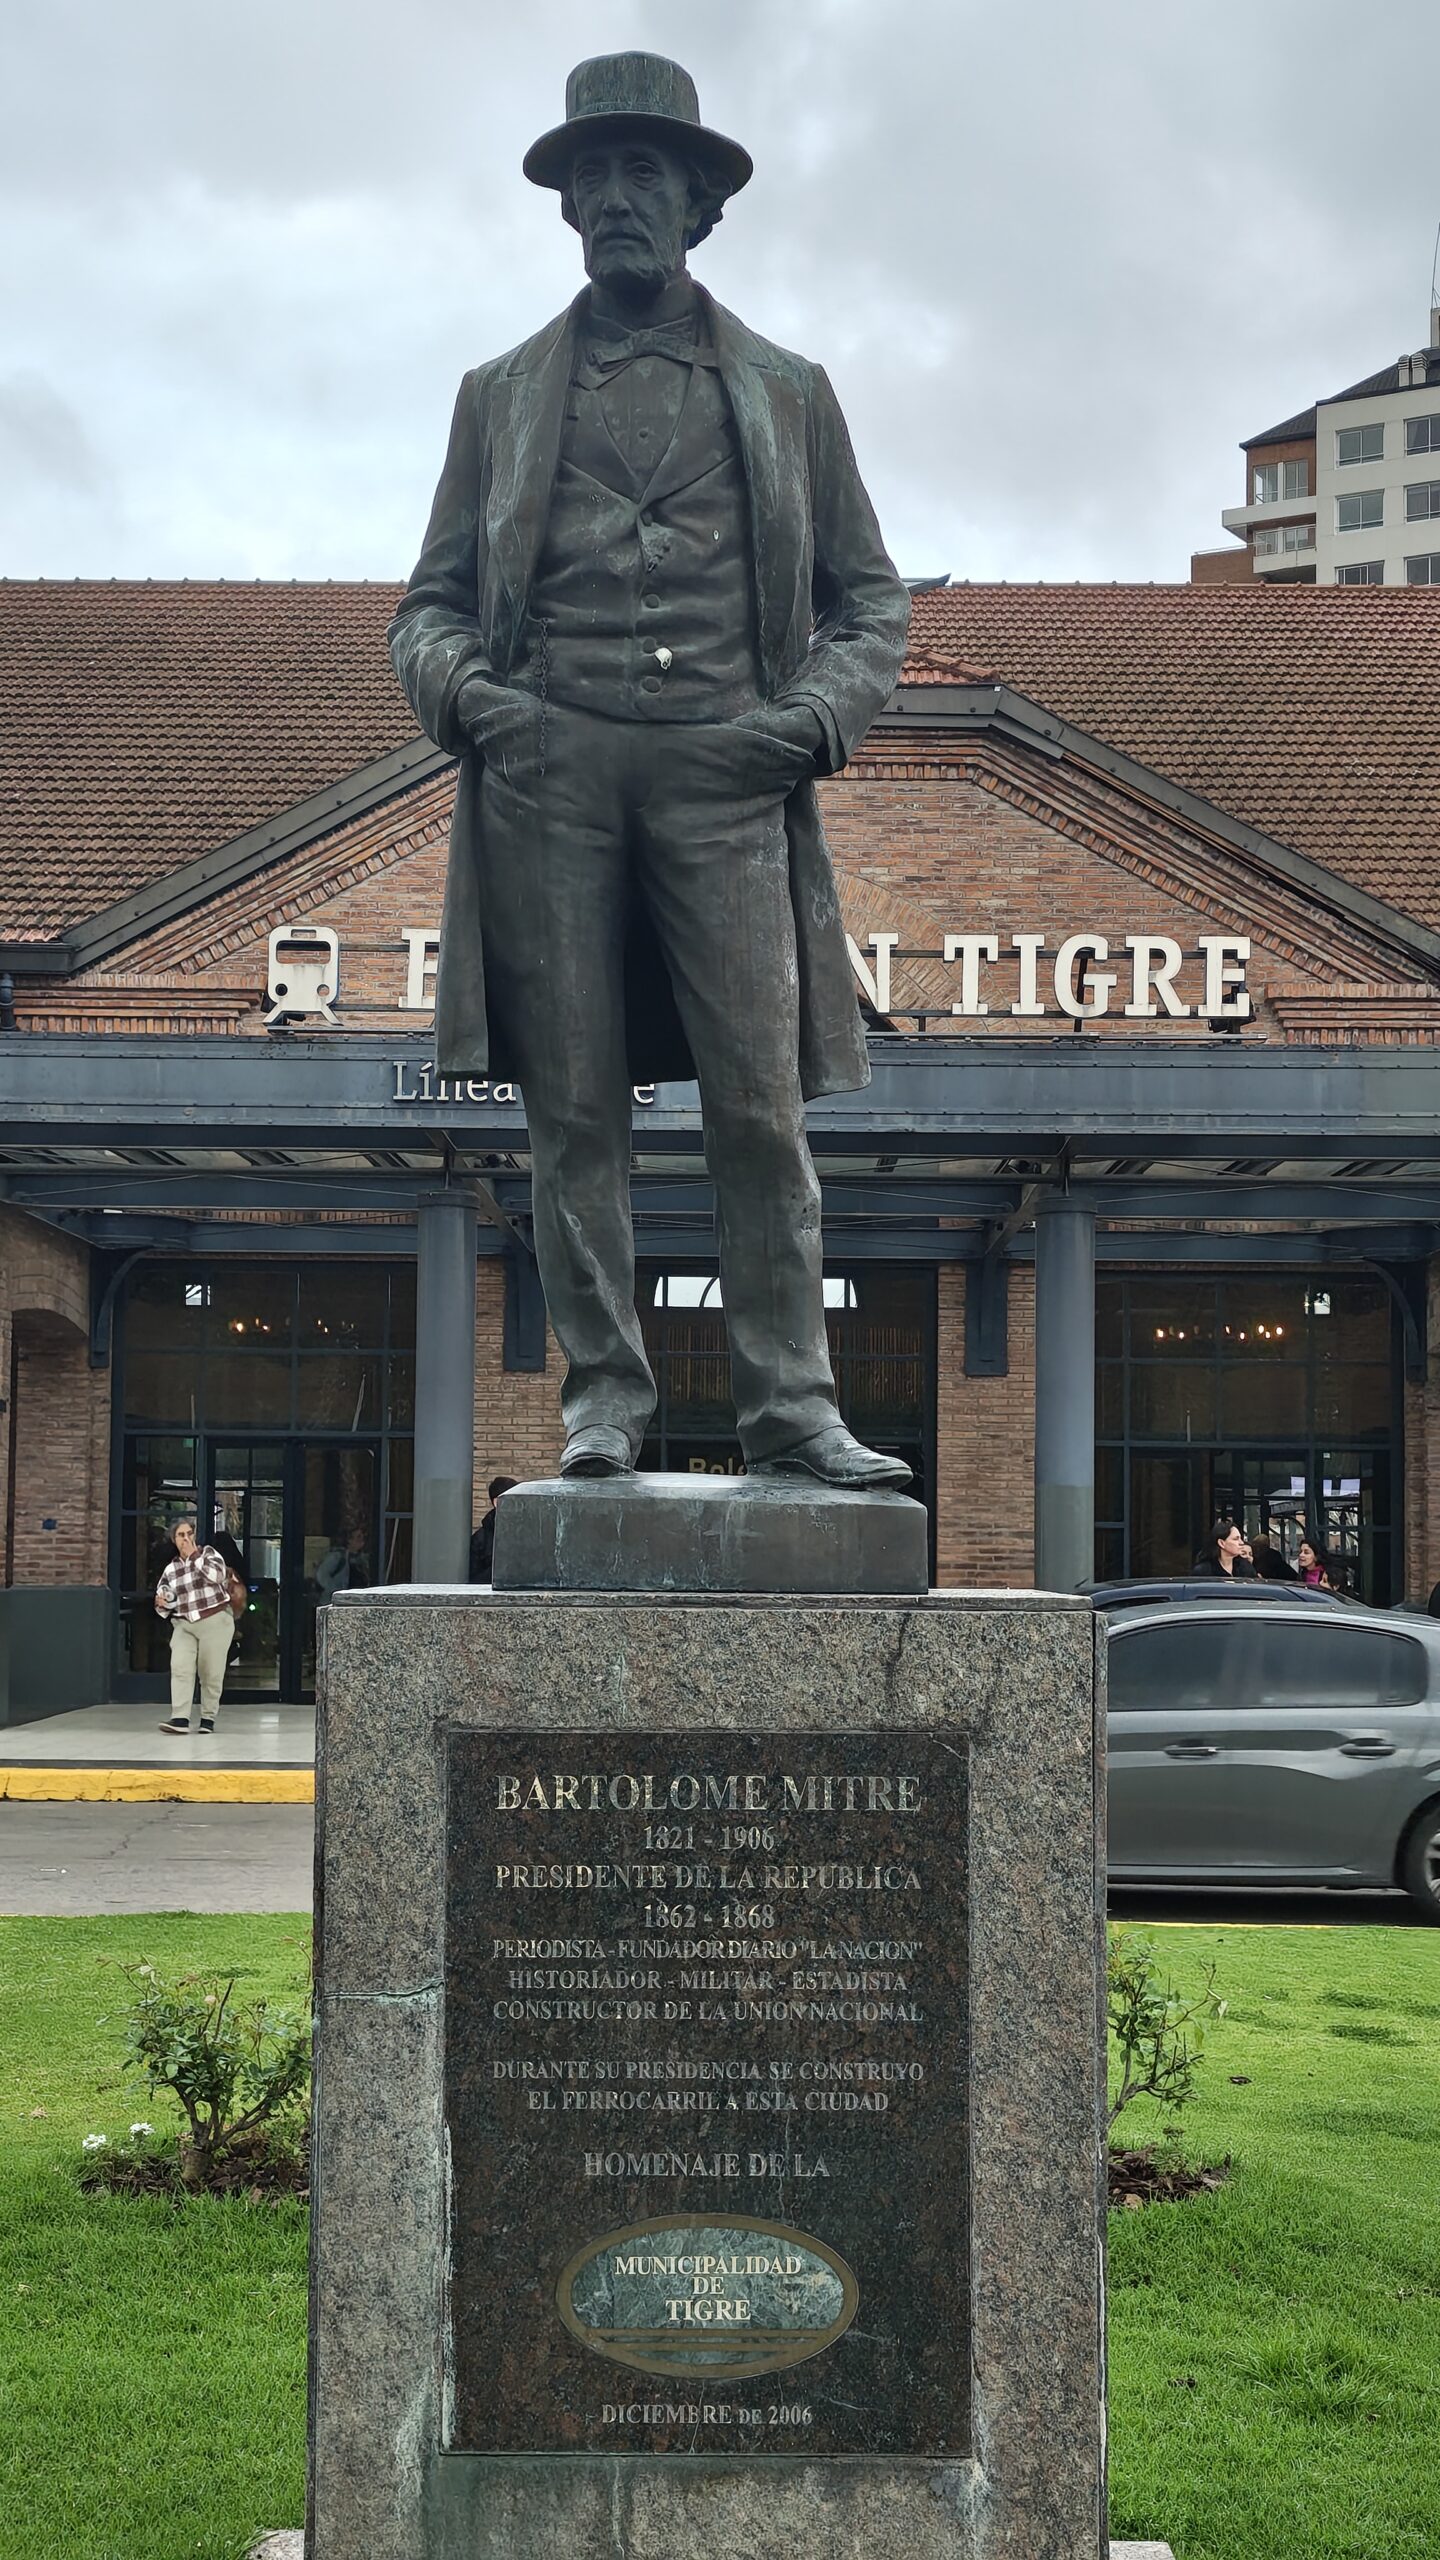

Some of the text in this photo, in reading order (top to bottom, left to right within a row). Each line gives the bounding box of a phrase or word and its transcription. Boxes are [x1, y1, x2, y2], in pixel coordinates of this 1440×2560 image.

[943, 933, 1251, 1018] TIGRE
[495, 1774, 922, 1812] BARTOLOME MITRE
[644, 1825, 696, 1850] 1821
[721, 1826, 775, 1851] 1906
[495, 1864, 922, 1890] PRESIDENTE DE LA REPUBLICA
[644, 1904, 697, 1929] 1862
[721, 1904, 775, 1929] 1868
[728, 1940, 797, 1960] DIARIO
[508, 1970, 662, 1989] HISTORIADOR
[680, 1970, 774, 1990] MILITAR
[792, 1971, 908, 1991] ESTADISTA
[493, 2000, 923, 2021] CONSTRUCTOR DE LA UNION NACIONAL
[493, 2061, 924, 2081] DURANTE SU PRESIDENCIA SE CONSTRUYO
[529, 2091, 889, 2111] EL FERROCARRIL A ESTA CIUDAD
[584, 2152, 831, 2178] HOMENAJE DE LA
[614, 2255, 802, 2276] MUNICIPALIDAD
[692, 2276, 725, 2295] DE
[665, 2299, 752, 2321] TIGRE
[602, 2404, 813, 2425] DICIEMBRE DE 2006
